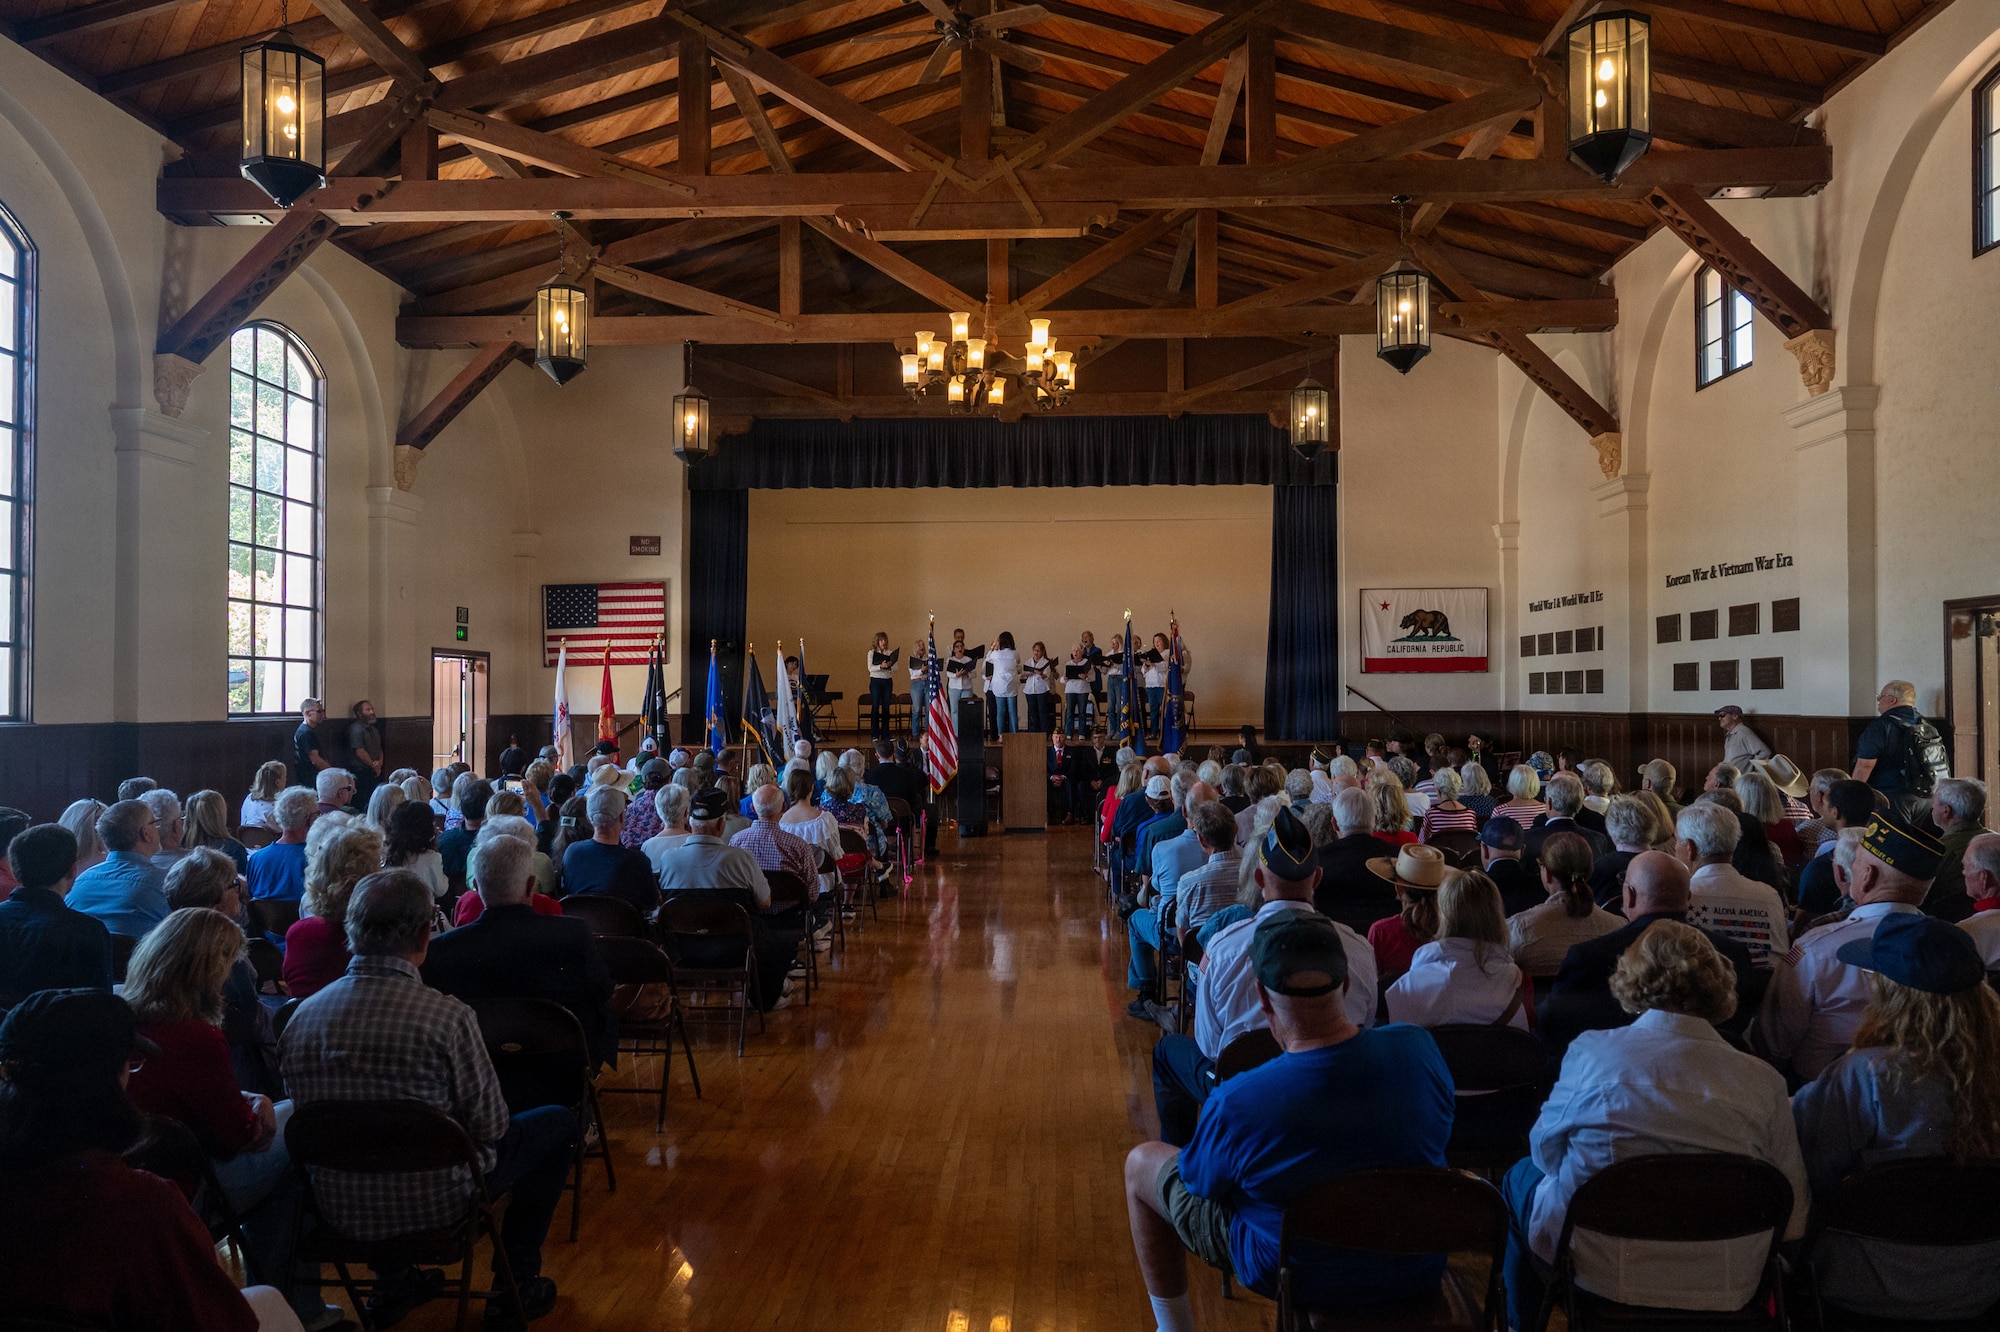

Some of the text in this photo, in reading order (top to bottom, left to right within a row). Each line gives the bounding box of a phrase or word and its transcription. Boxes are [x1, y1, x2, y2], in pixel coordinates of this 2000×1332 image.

[631, 545, 659, 553] SMOKING
[1665, 553, 1793, 588] Korean War & Vietnam War Era
[1529, 600, 1543, 613] World
[1543, 599, 1553, 610] War
[1556, 597, 1561, 608] &
[1561, 593, 1577, 607] World
[1577, 593, 1589, 605] War
[1589, 591, 1595, 603] II
[1387, 644, 1465, 654] CALIFORNIA REPUBLIC
[1713, 907, 1769, 918] ALOHA AMERICA
